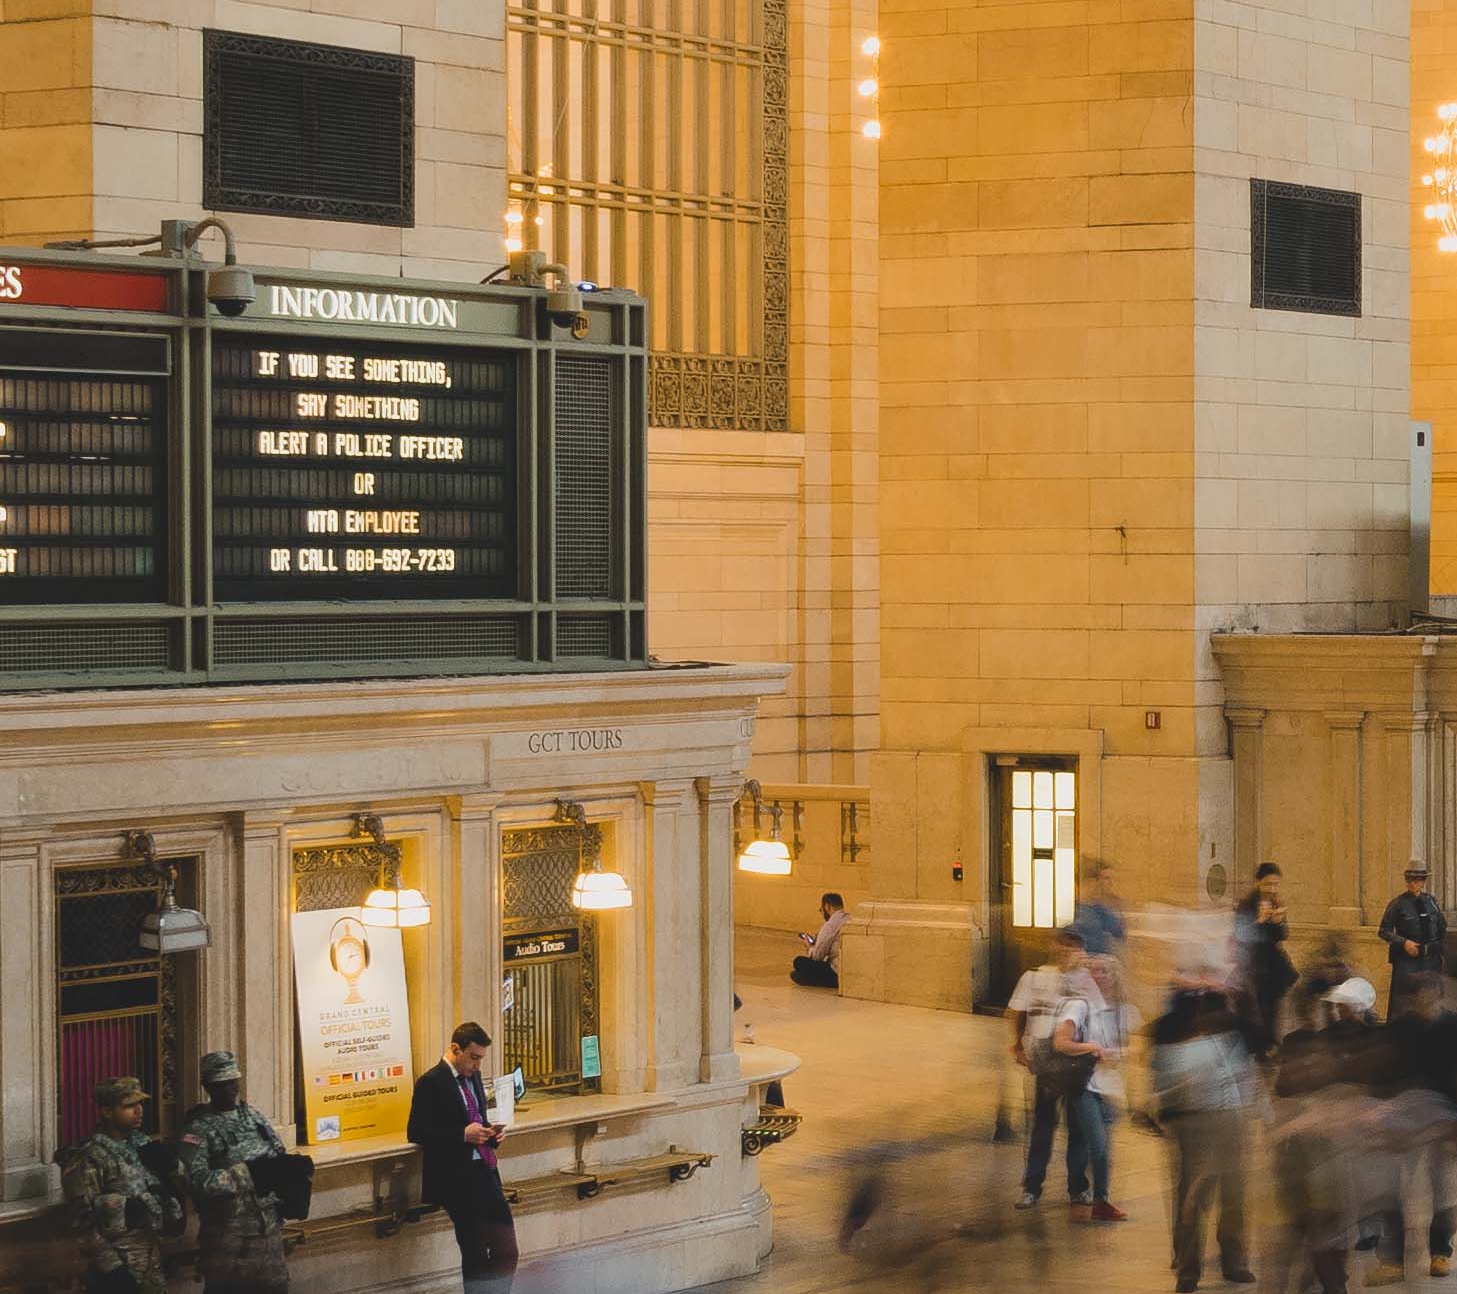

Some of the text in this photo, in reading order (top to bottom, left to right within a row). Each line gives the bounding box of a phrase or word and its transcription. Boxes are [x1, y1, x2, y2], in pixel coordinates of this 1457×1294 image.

[271, 286, 458, 328] INFORMATION
[259, 352, 451, 388] IF YOU SEE SOMETHING,
[298, 394, 419, 420] SAY SOMETHING
[259, 432, 462, 461] ALERT A POLICE OFFICER
[354, 473, 374, 494] OR
[307, 510, 419, 533] MTA EMPLOYEE
[271, 549, 290, 571] OR
[299, 549, 338, 571] CALL
[528, 728, 623, 754] GCT TOURS
[515, 938, 565, 957] Audio Tours
